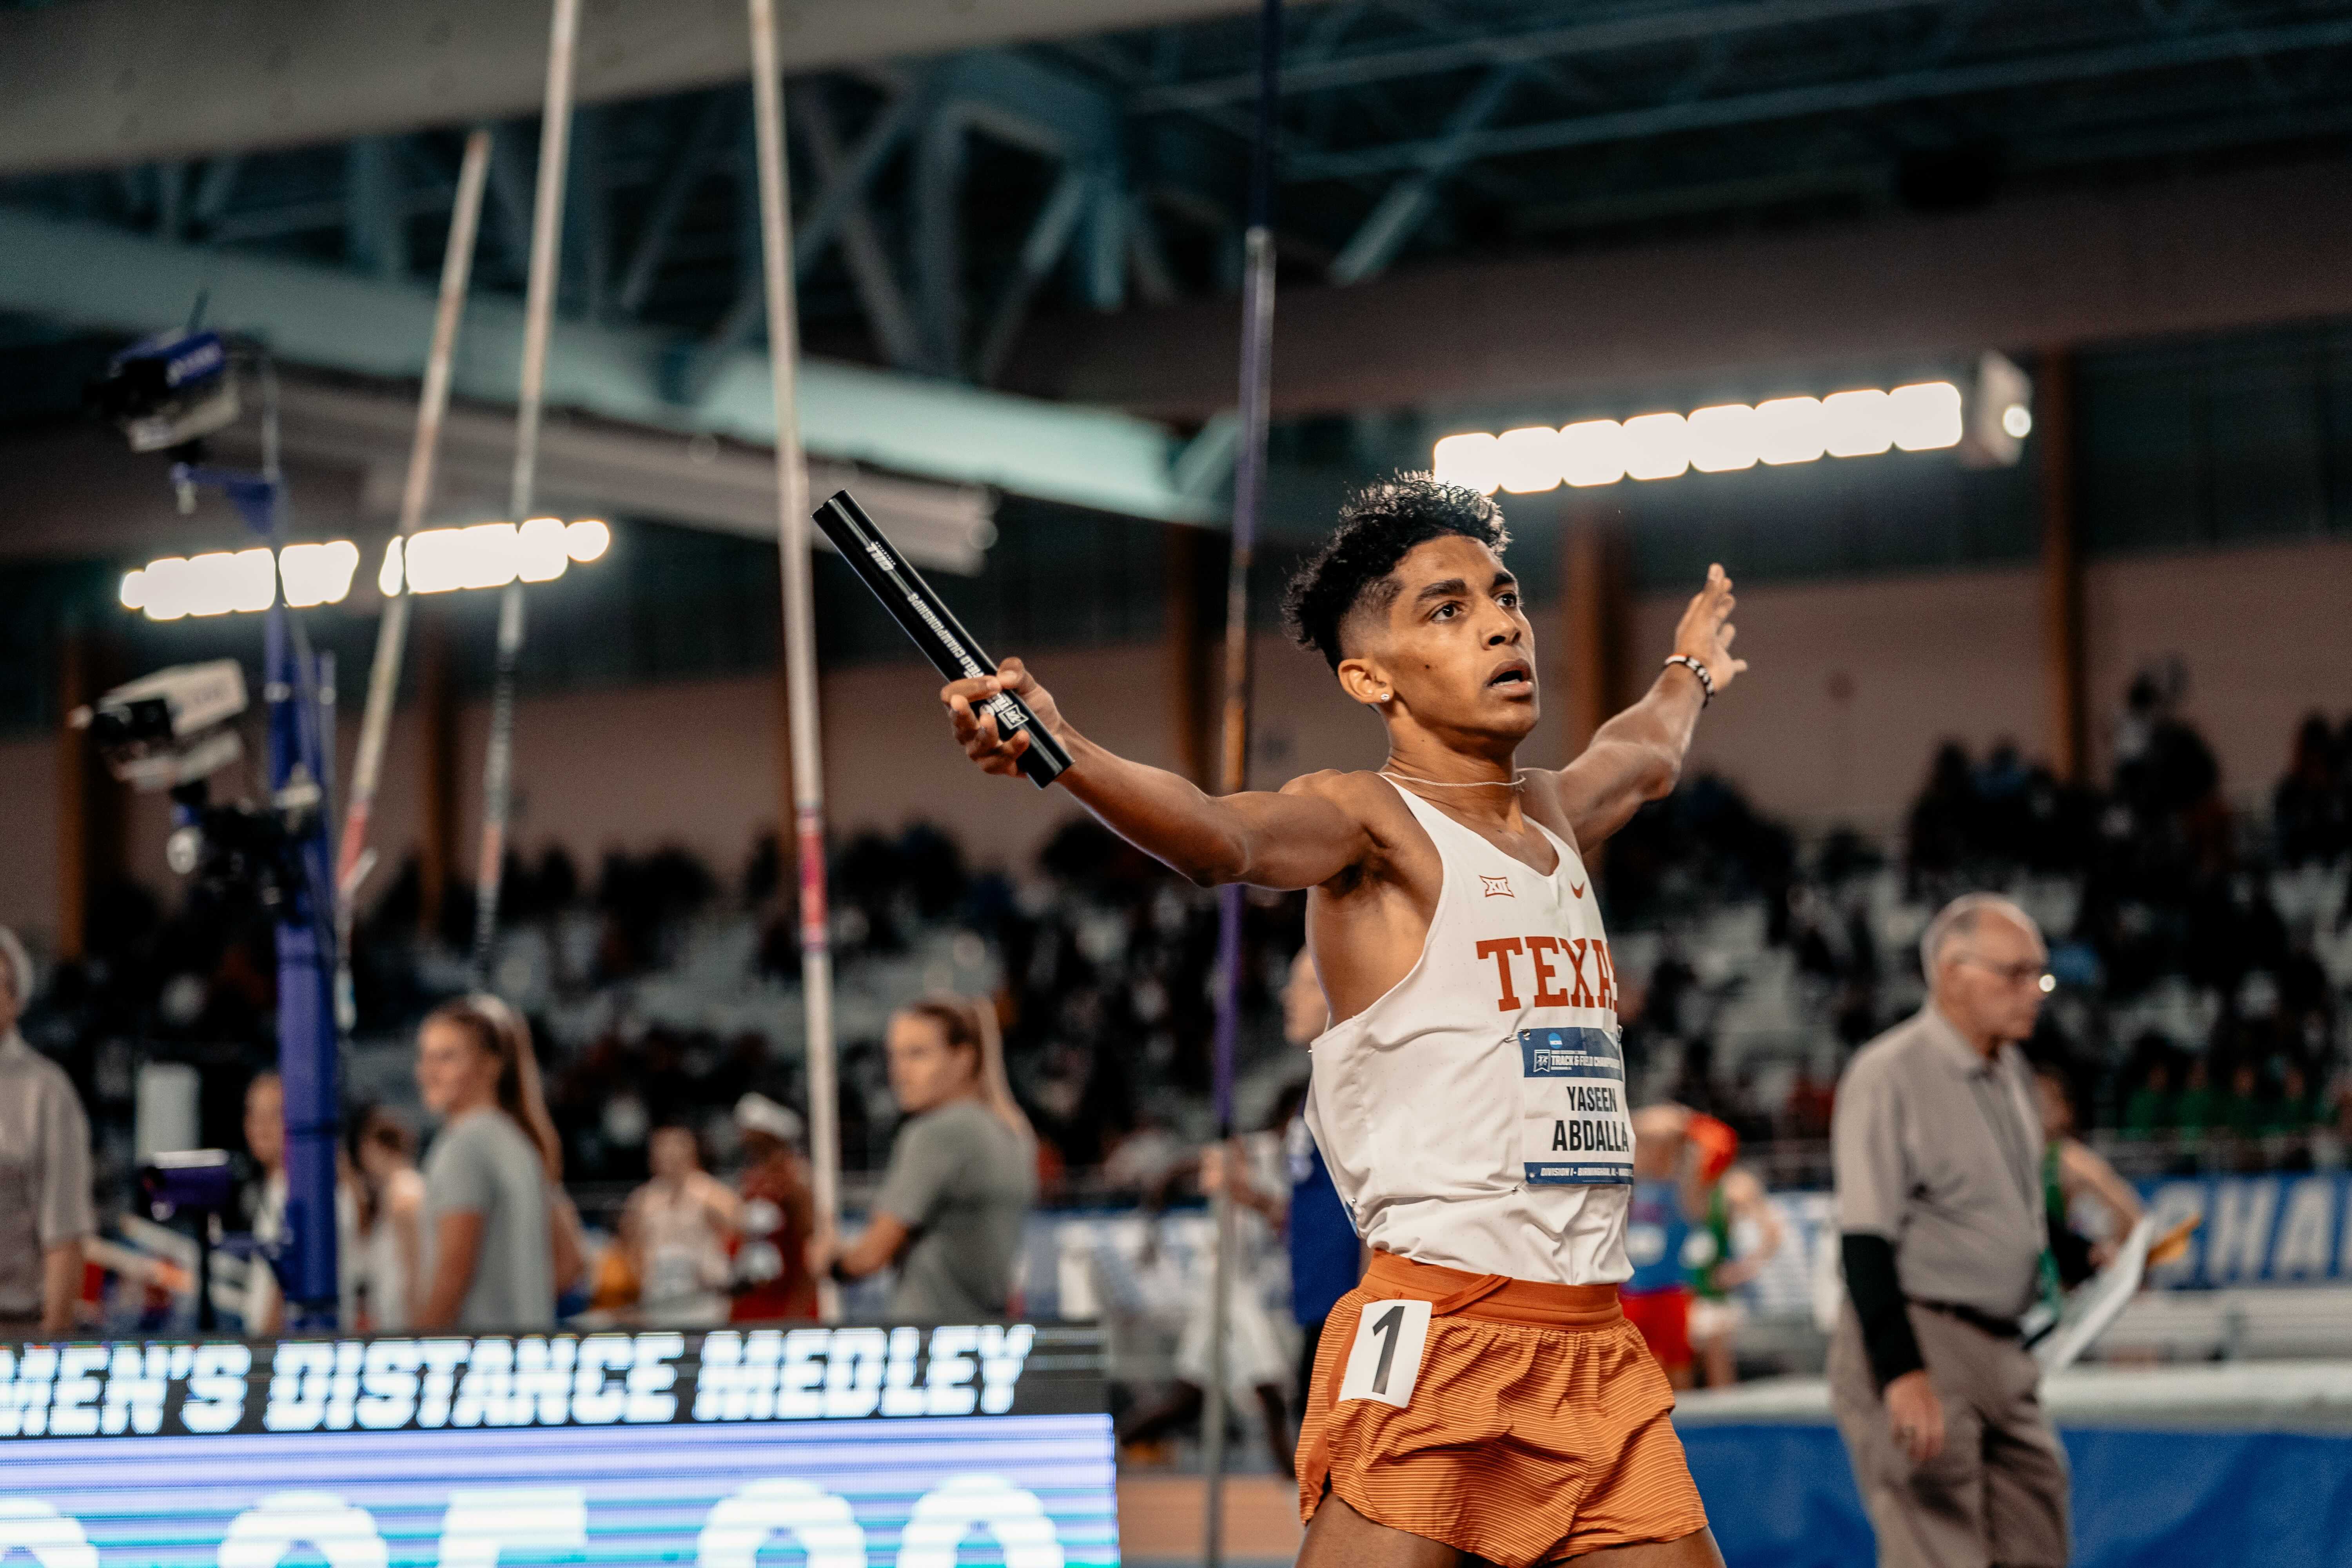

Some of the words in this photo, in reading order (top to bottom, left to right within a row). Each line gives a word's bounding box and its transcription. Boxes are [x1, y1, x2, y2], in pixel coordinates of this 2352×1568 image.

[866, 542, 893, 571] GILL
[907, 592, 966, 659] CHAMPIONSHIPS
[960, 654, 984, 679] FIELD
[1476, 936, 1617, 1012] TEXA
[1566, 1086, 1617, 1112] YASEEN
[1552, 1120, 1630, 1152] ABDALLA
[2148, 1179, 2352, 1272] CHA
[263, 1333, 685, 1432] DISTANCE
[692, 1324, 1036, 1421] MEDLEY
[1372, 1306, 1405, 1395] 1
